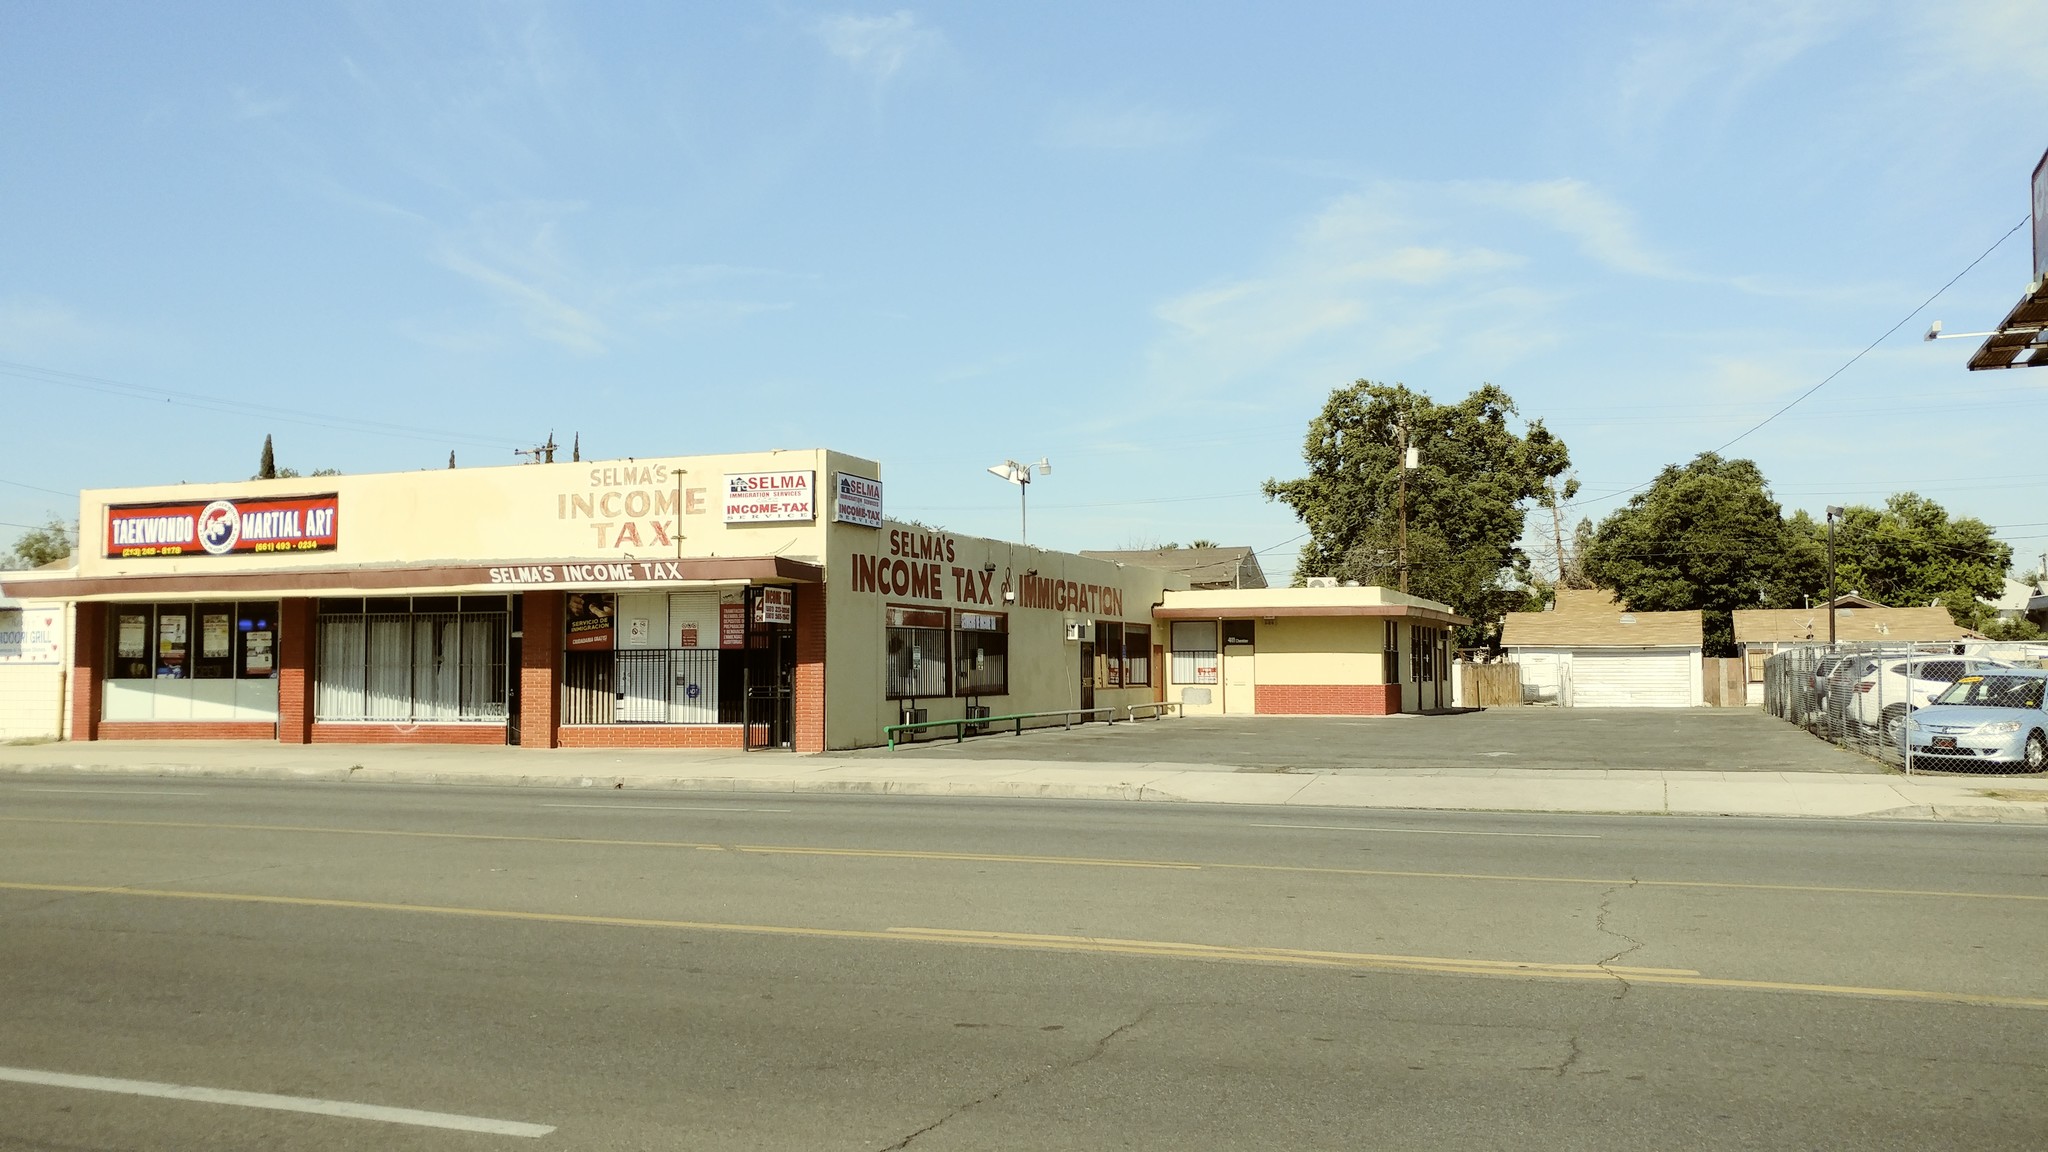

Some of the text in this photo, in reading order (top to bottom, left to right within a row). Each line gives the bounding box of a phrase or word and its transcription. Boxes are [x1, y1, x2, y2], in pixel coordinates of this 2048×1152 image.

[590, 464, 668, 487] SELMA'S
[748, 475, 807, 490] SELMA
[729, 491, 770, 499] IMMIGRATION
[850, 479, 880, 499] SELMA
[558, 487, 707, 519] INCOME
[726, 502, 809, 515] INCOME-TAX
[839, 503, 880, 521] INCOME-TAX
[112, 516, 194, 545] TAEKWONDO
[242, 508, 334, 540] MARTIAL ART
[590, 520, 673, 549] TAX
[890, 529, 955, 563] SELMA'S
[489, 562, 683, 583] SELMA'S INCOME TAX
[851, 553, 943, 600] INCOME
[951, 566, 994, 606] TAX
[1018, 573, 1123, 617] IMMIGRATION
[31, 631, 51, 644] GRILL
